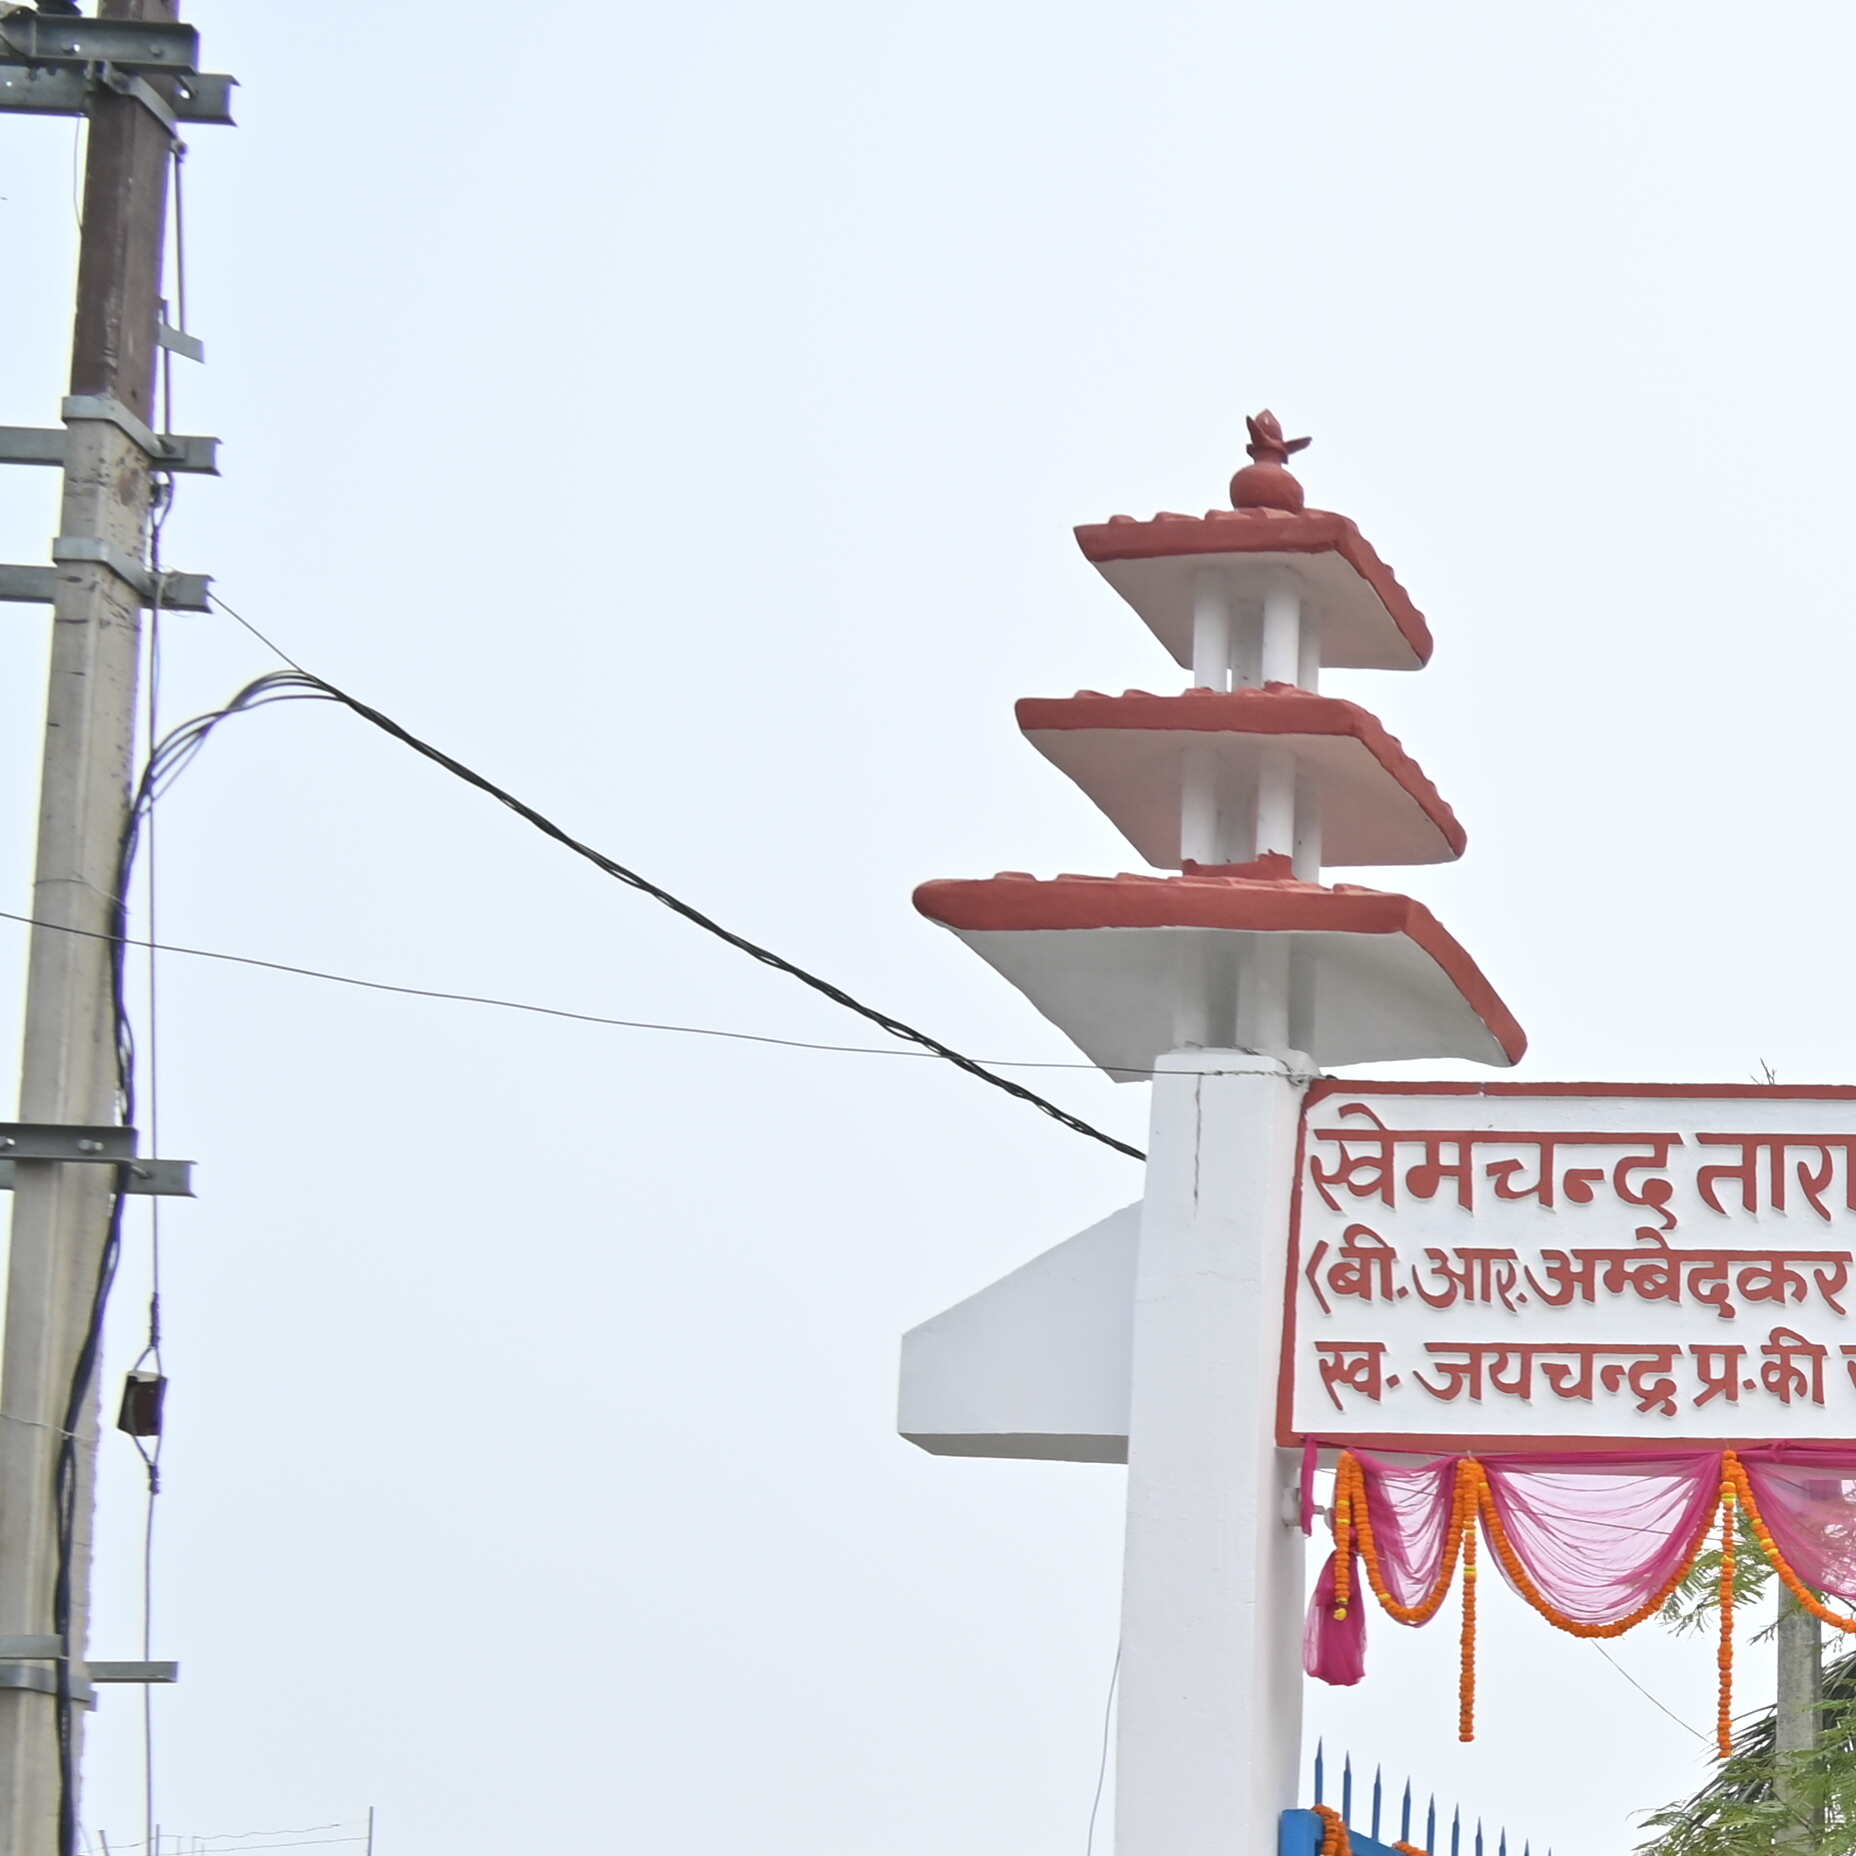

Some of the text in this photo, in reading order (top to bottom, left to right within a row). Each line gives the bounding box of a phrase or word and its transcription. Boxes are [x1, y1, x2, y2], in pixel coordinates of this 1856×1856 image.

[1309, 1102, 1684, 1231] खेमचन्द
[1313, 1340, 1401, 1411] स्व.
[1412, 1341, 1684, 1417] जयचन्द्र
